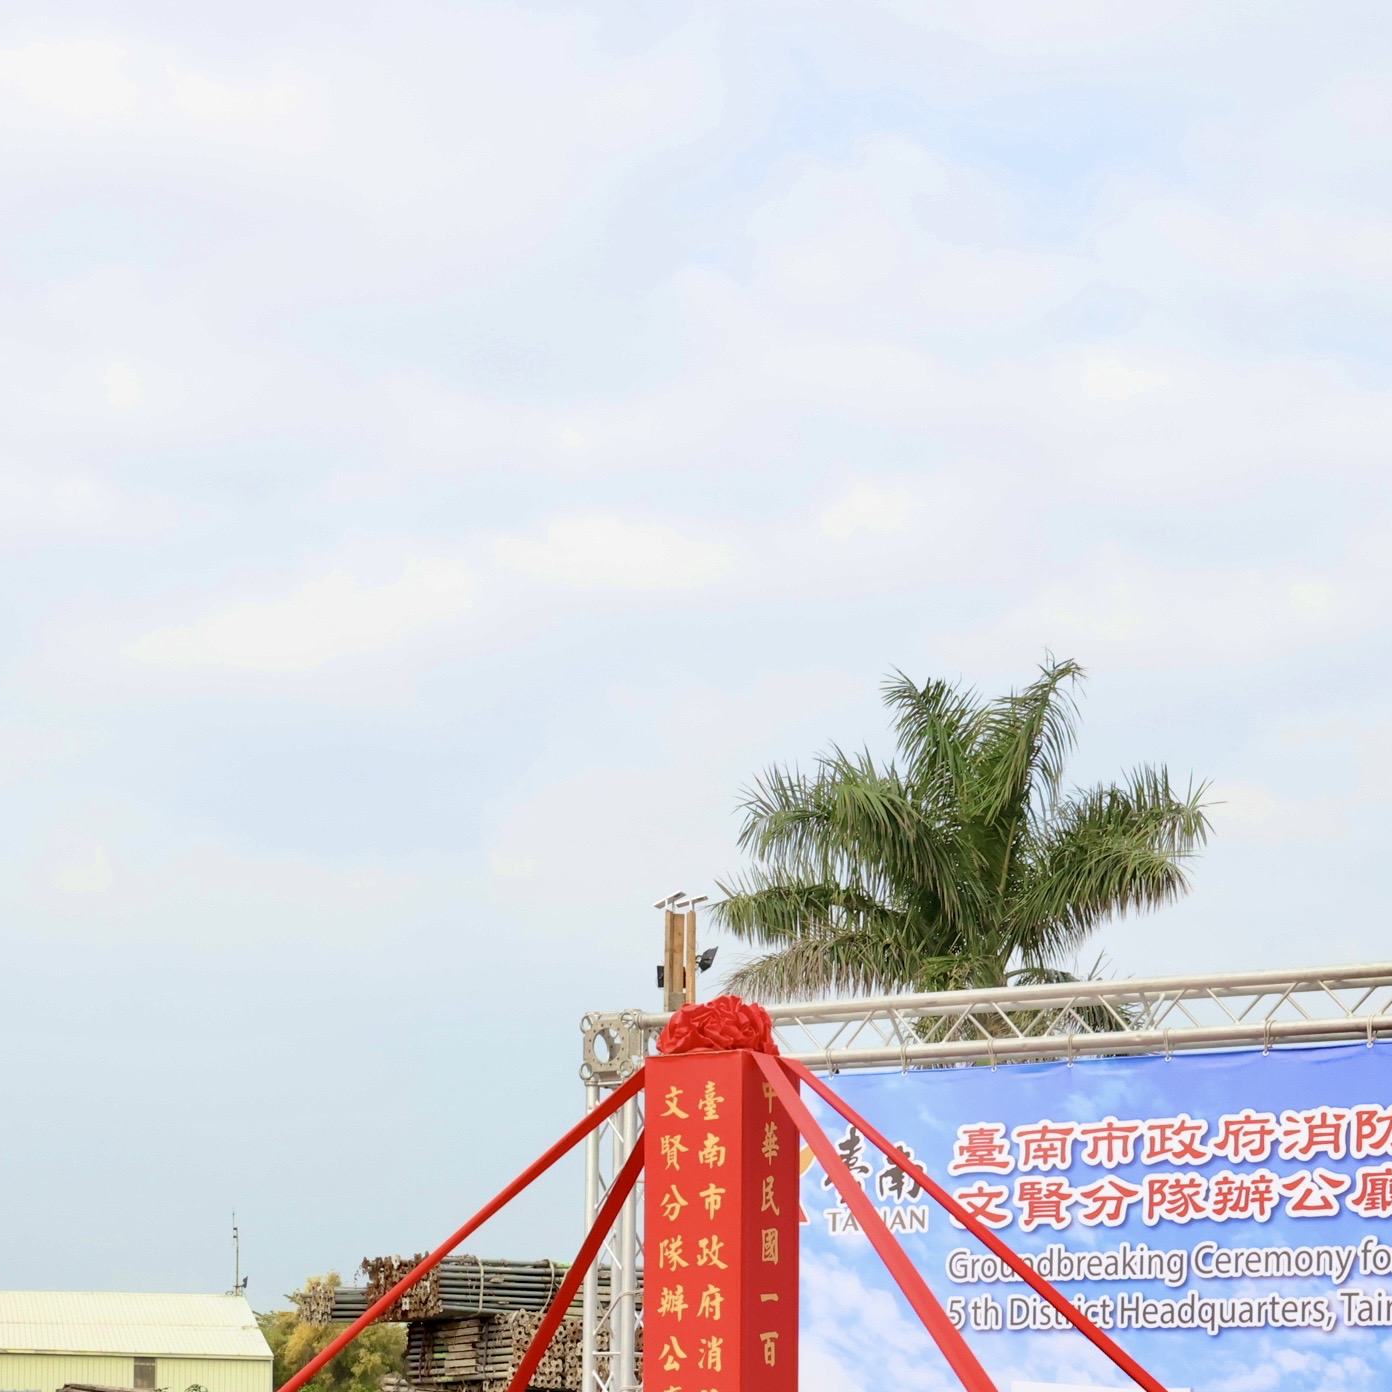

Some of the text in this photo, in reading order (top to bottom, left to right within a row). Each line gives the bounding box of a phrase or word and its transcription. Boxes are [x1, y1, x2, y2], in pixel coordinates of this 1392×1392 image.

[827, 1208, 926, 1232] TAAN
[1194, 1244, 1352, 1280] Ceremony
[1120, 1294, 1332, 1331] Headquarters,
